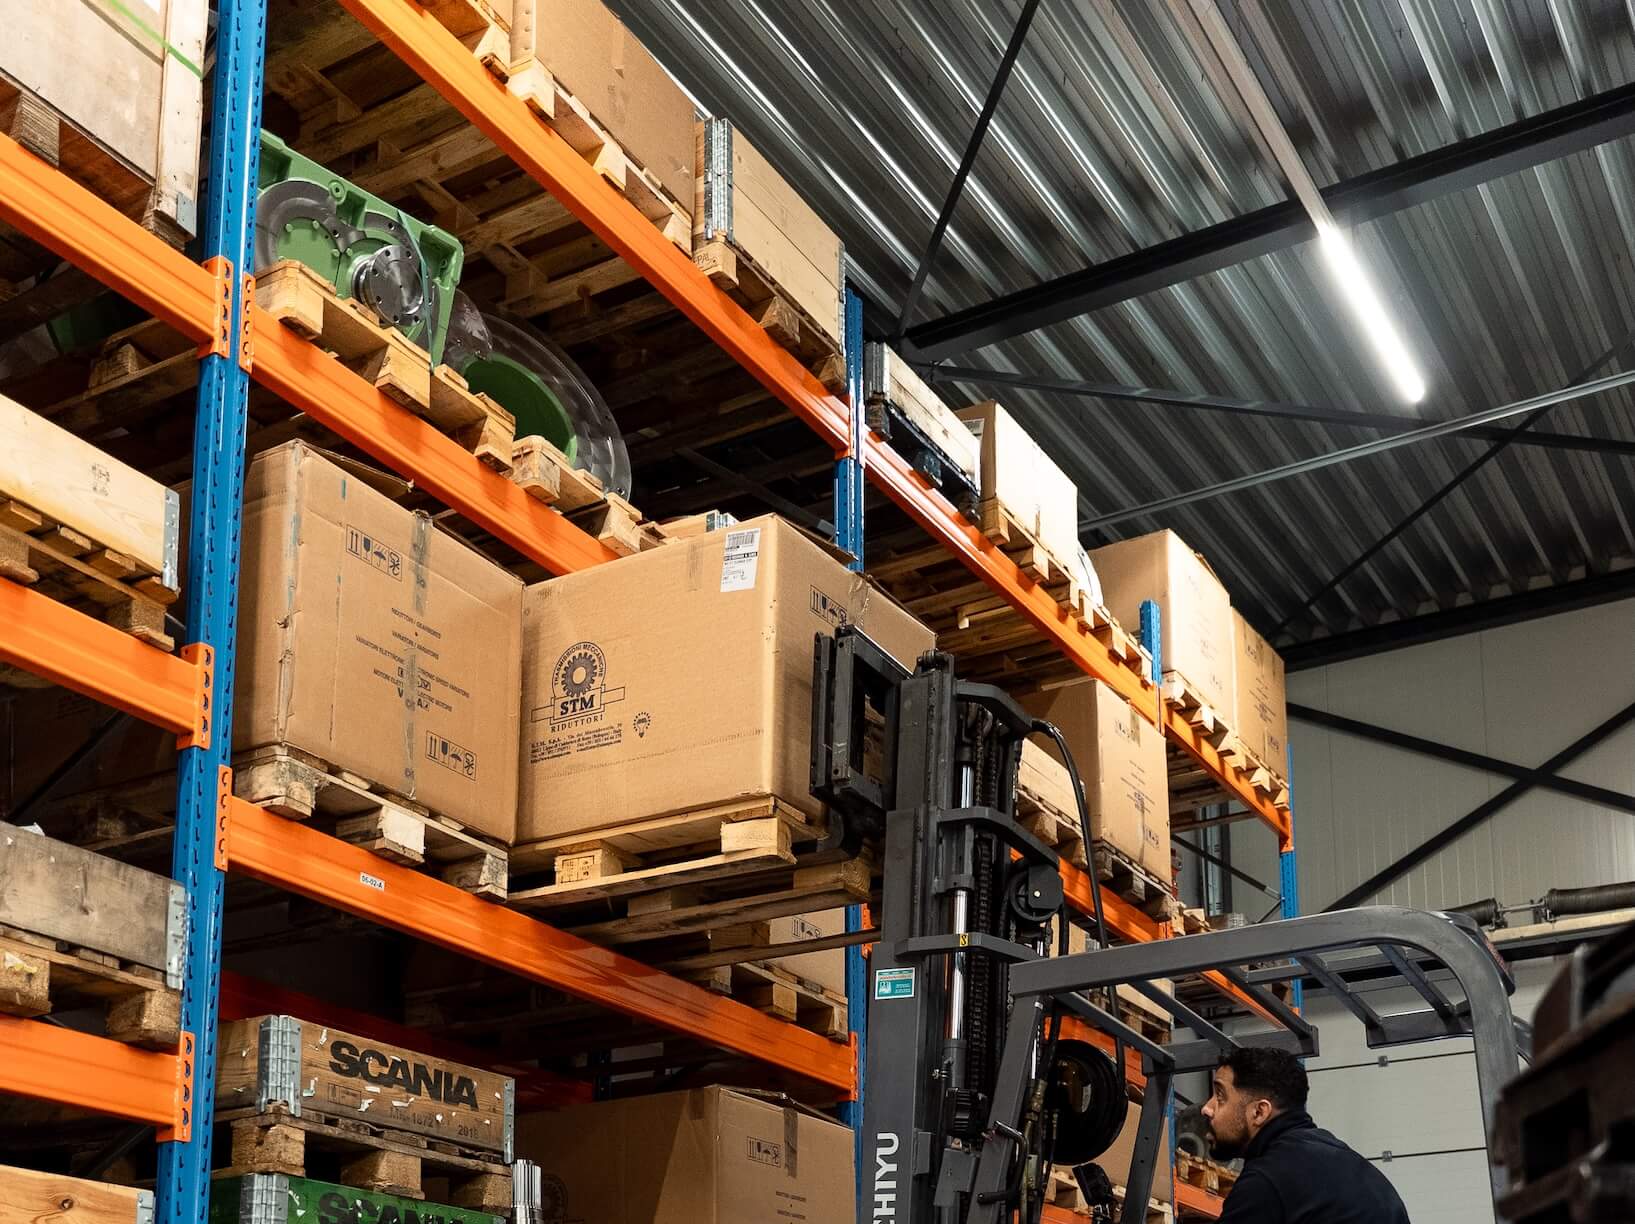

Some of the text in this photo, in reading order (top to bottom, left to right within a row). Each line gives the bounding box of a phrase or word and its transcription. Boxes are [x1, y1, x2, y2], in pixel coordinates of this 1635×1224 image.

[560, 694, 596, 716] STM
[551, 714, 604, 733] RIDUTTORI
[329, 1041, 479, 1112] SCANIA
